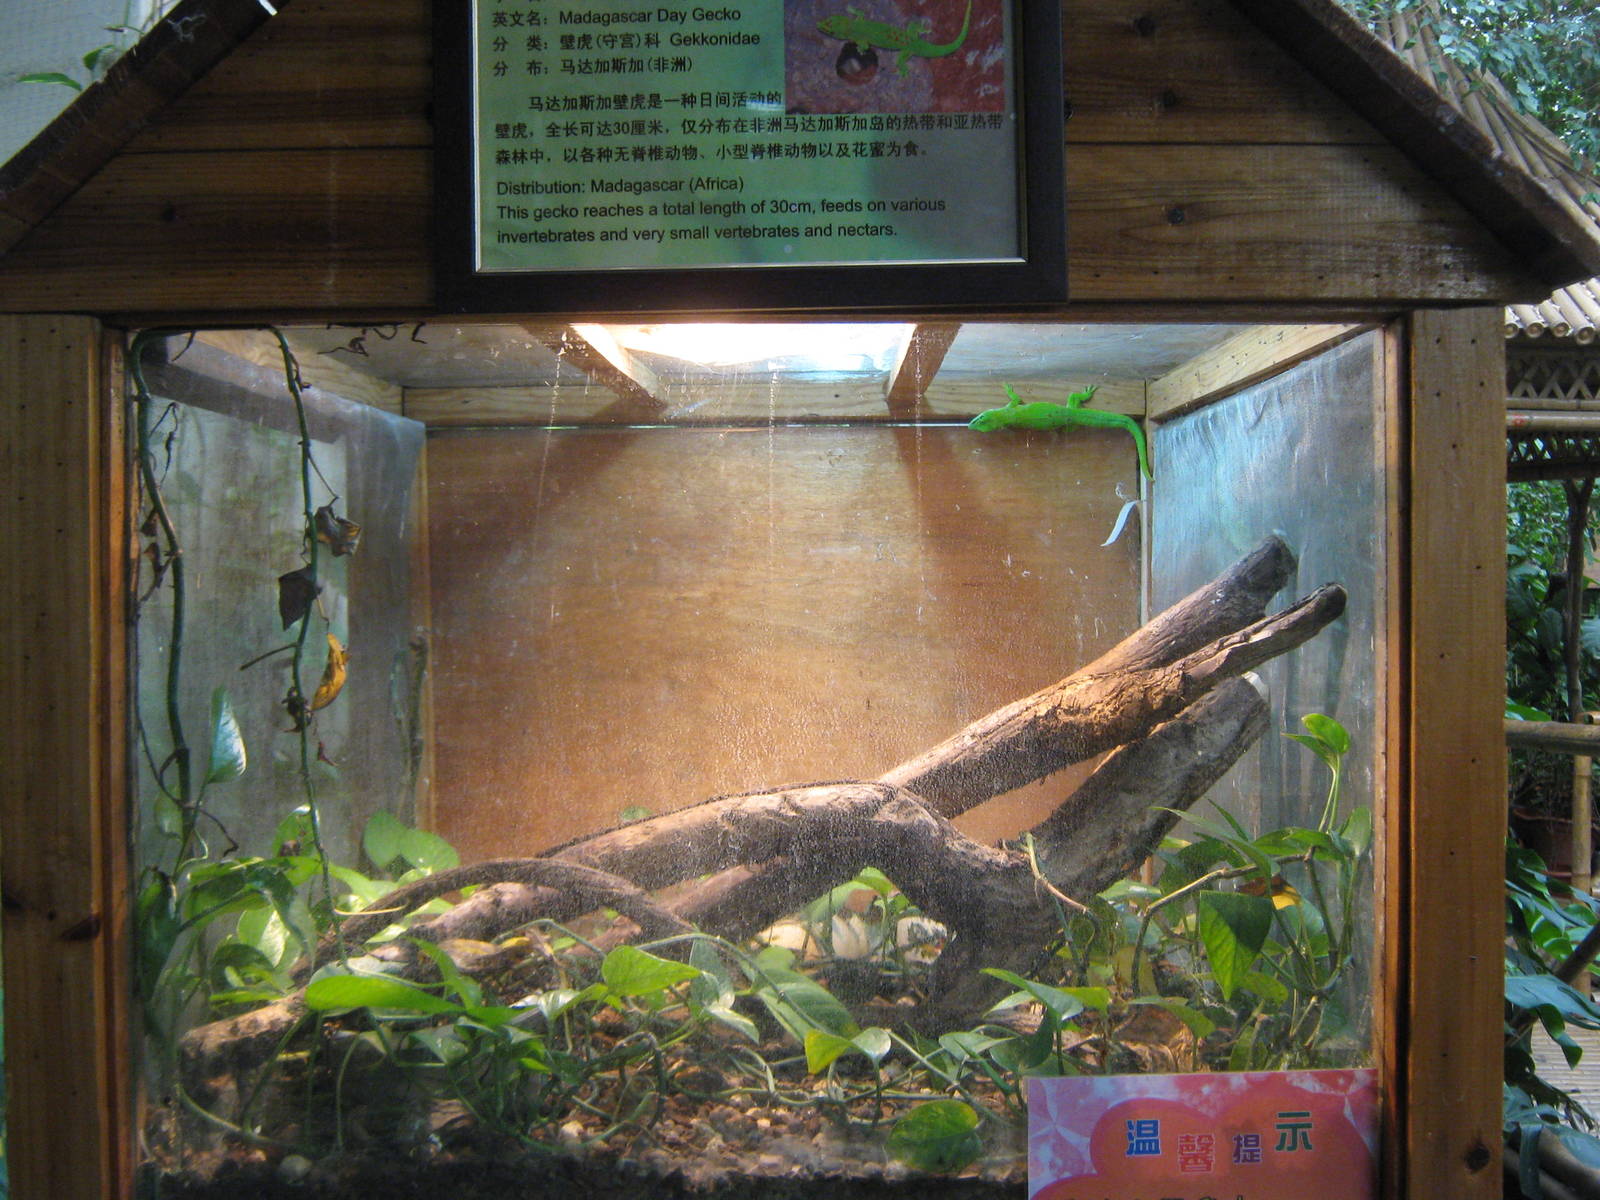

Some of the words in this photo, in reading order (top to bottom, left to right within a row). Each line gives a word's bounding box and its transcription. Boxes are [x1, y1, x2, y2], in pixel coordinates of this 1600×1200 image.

[560, 10, 652, 26] Madagascar
[658, 9, 687, 25] Day
[692, 7, 741, 21] Gecko
[670, 32, 761, 47] Gekkonidae
[528, 91, 781, 112] 马达加斯加壁虎是一种日间活动的
[497, 181, 586, 196] Distribution:
[590, 178, 684, 195] Madagascar
[689, 177, 744, 194] (Africa)
[497, 205, 529, 220] This
[533, 203, 579, 222] gecko
[583, 202, 644, 218] reaches
[648, 206, 658, 217] a
[662, 201, 694, 217] total
[699, 200, 746, 219] length
[750, 199, 766, 215] of
[769, 199, 815, 217] 30cm,
[820, 198, 863, 214] feeds
[867, 202, 886, 213] on
[890, 198, 946, 213] various
[497, 227, 595, 244] invertebrates
[599, 226, 628, 242] and
[633, 229, 665, 245] very
[670, 225, 709, 241] small
[714, 224, 799, 240] vertebrates
[804, 222, 833, 238] and
[837, 221, 898, 238] nectars.
[1125, 1111, 1313, 1174] 温馨提示
